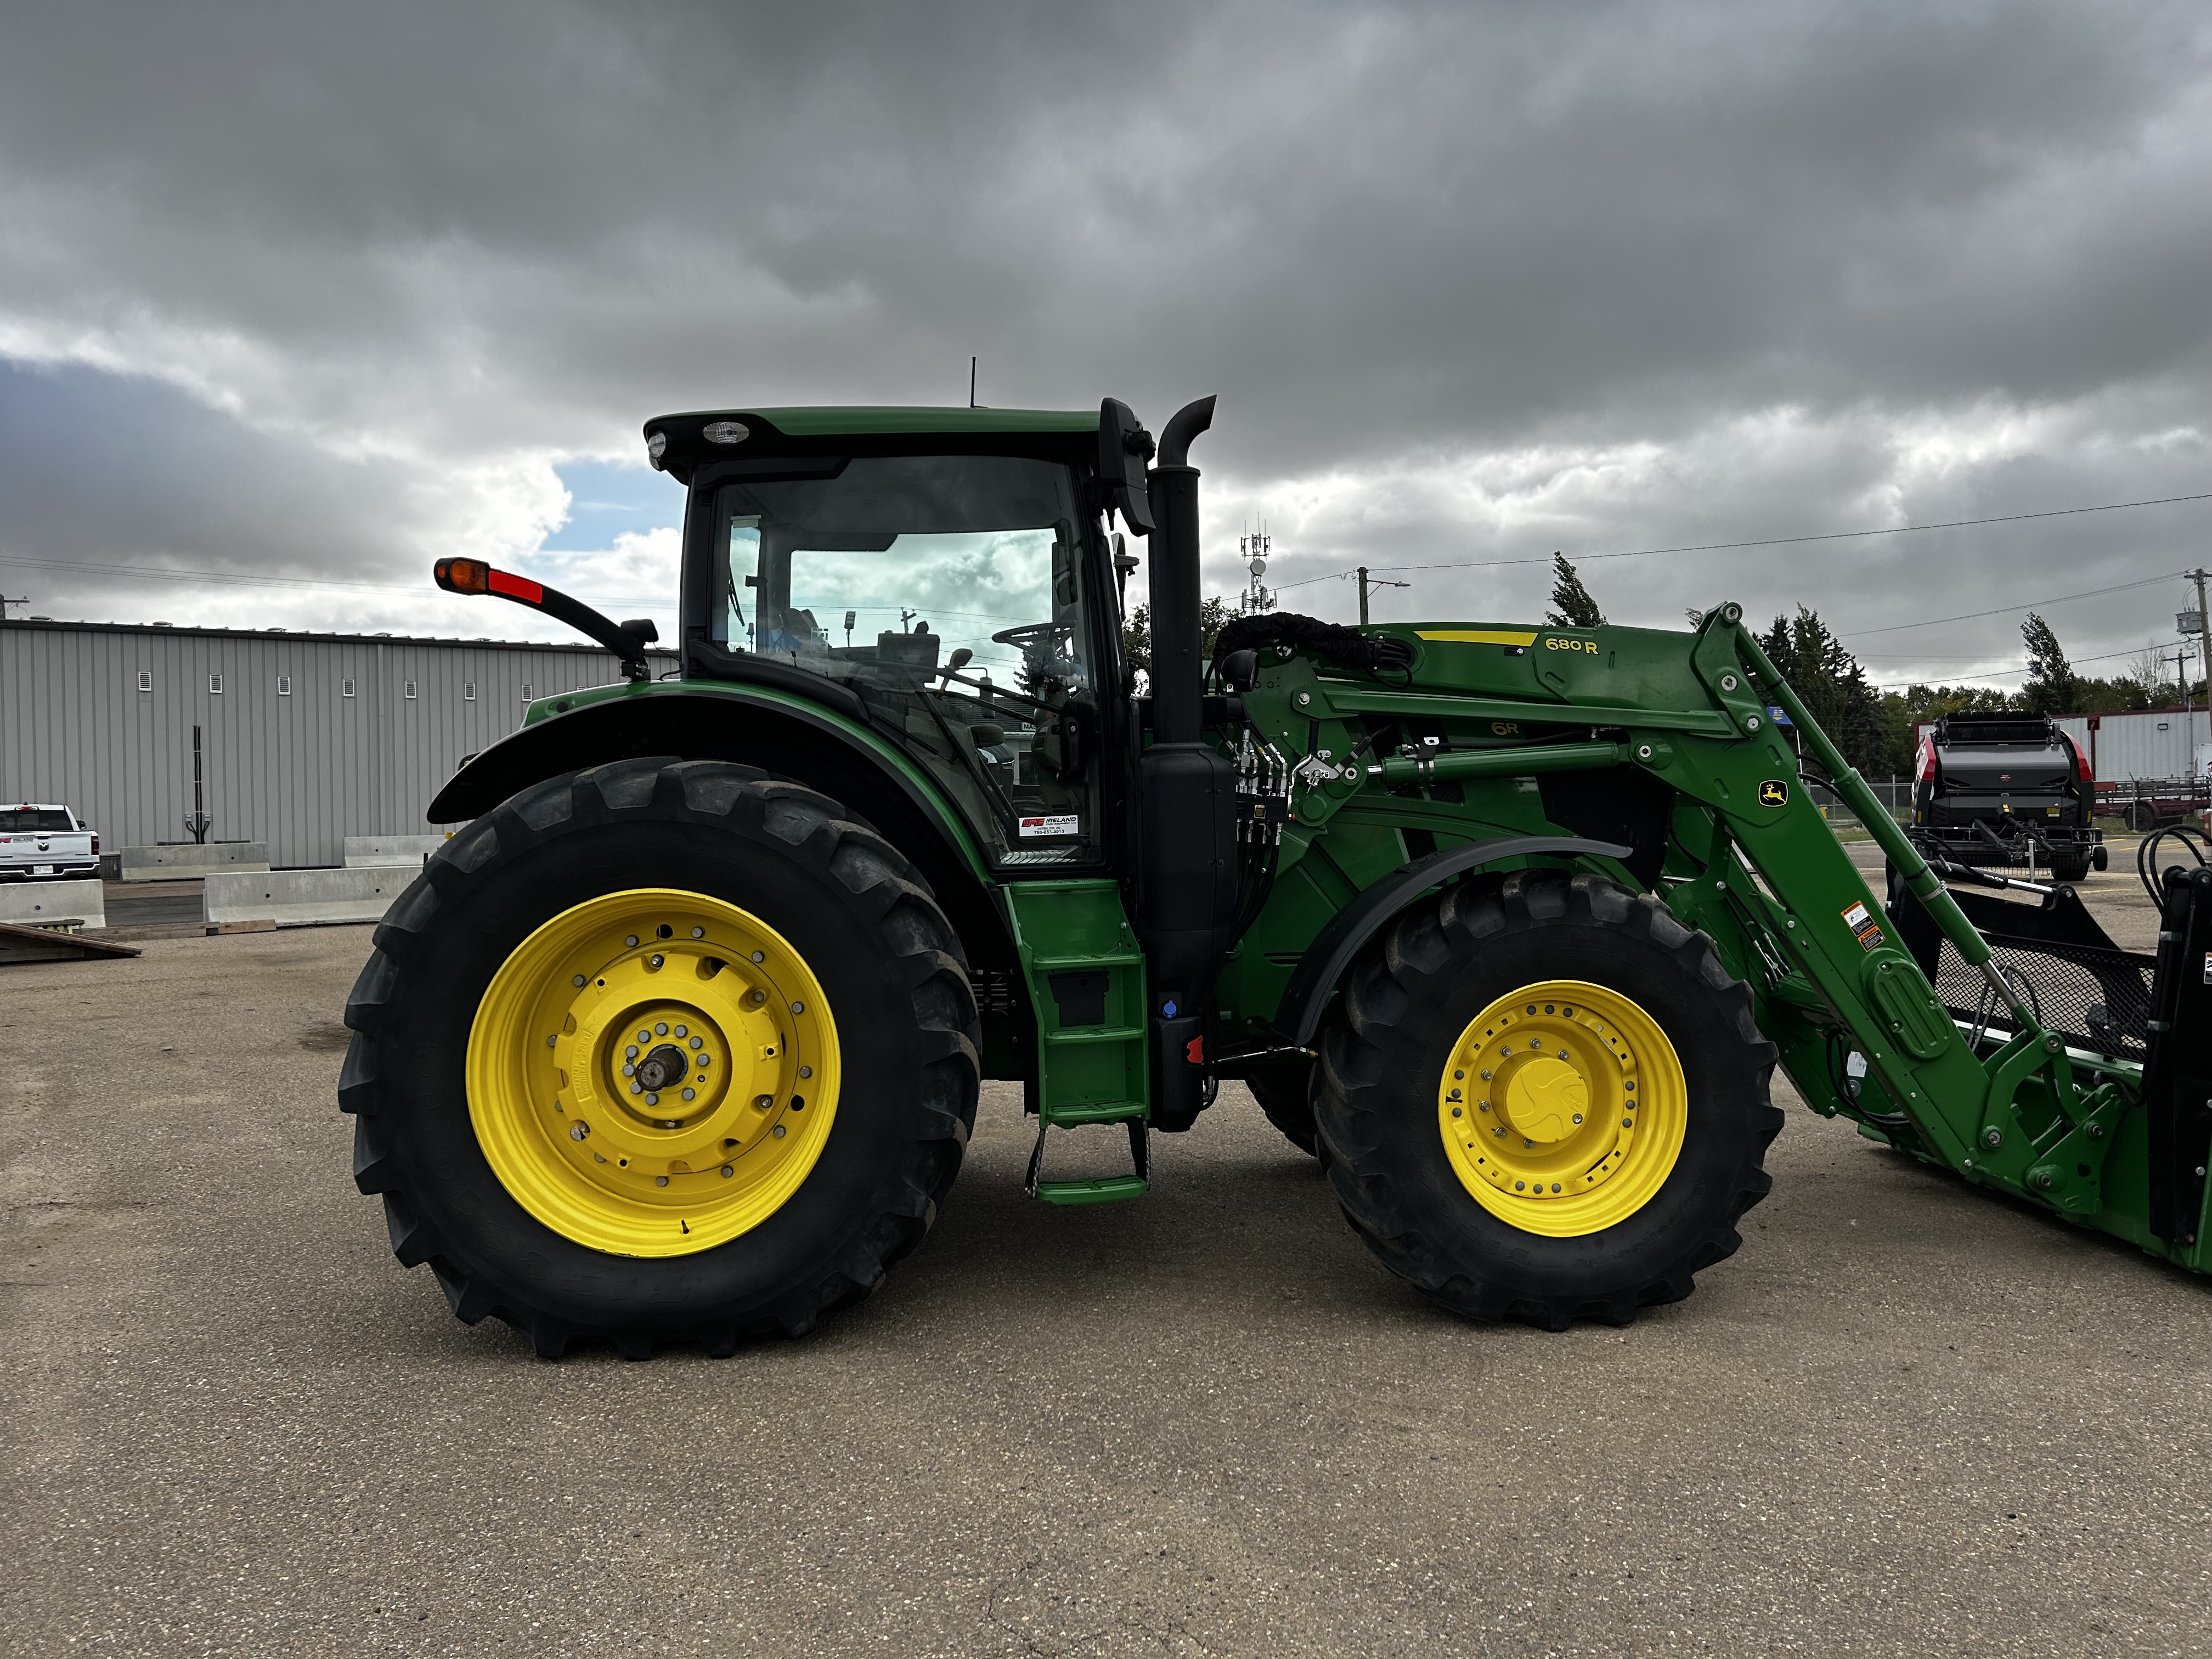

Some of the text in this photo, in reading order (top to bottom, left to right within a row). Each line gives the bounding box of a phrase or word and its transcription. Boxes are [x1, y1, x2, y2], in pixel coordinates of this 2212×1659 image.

[1545, 637, 1599, 655] 680 R
[1491, 721, 1519, 735] 6R
